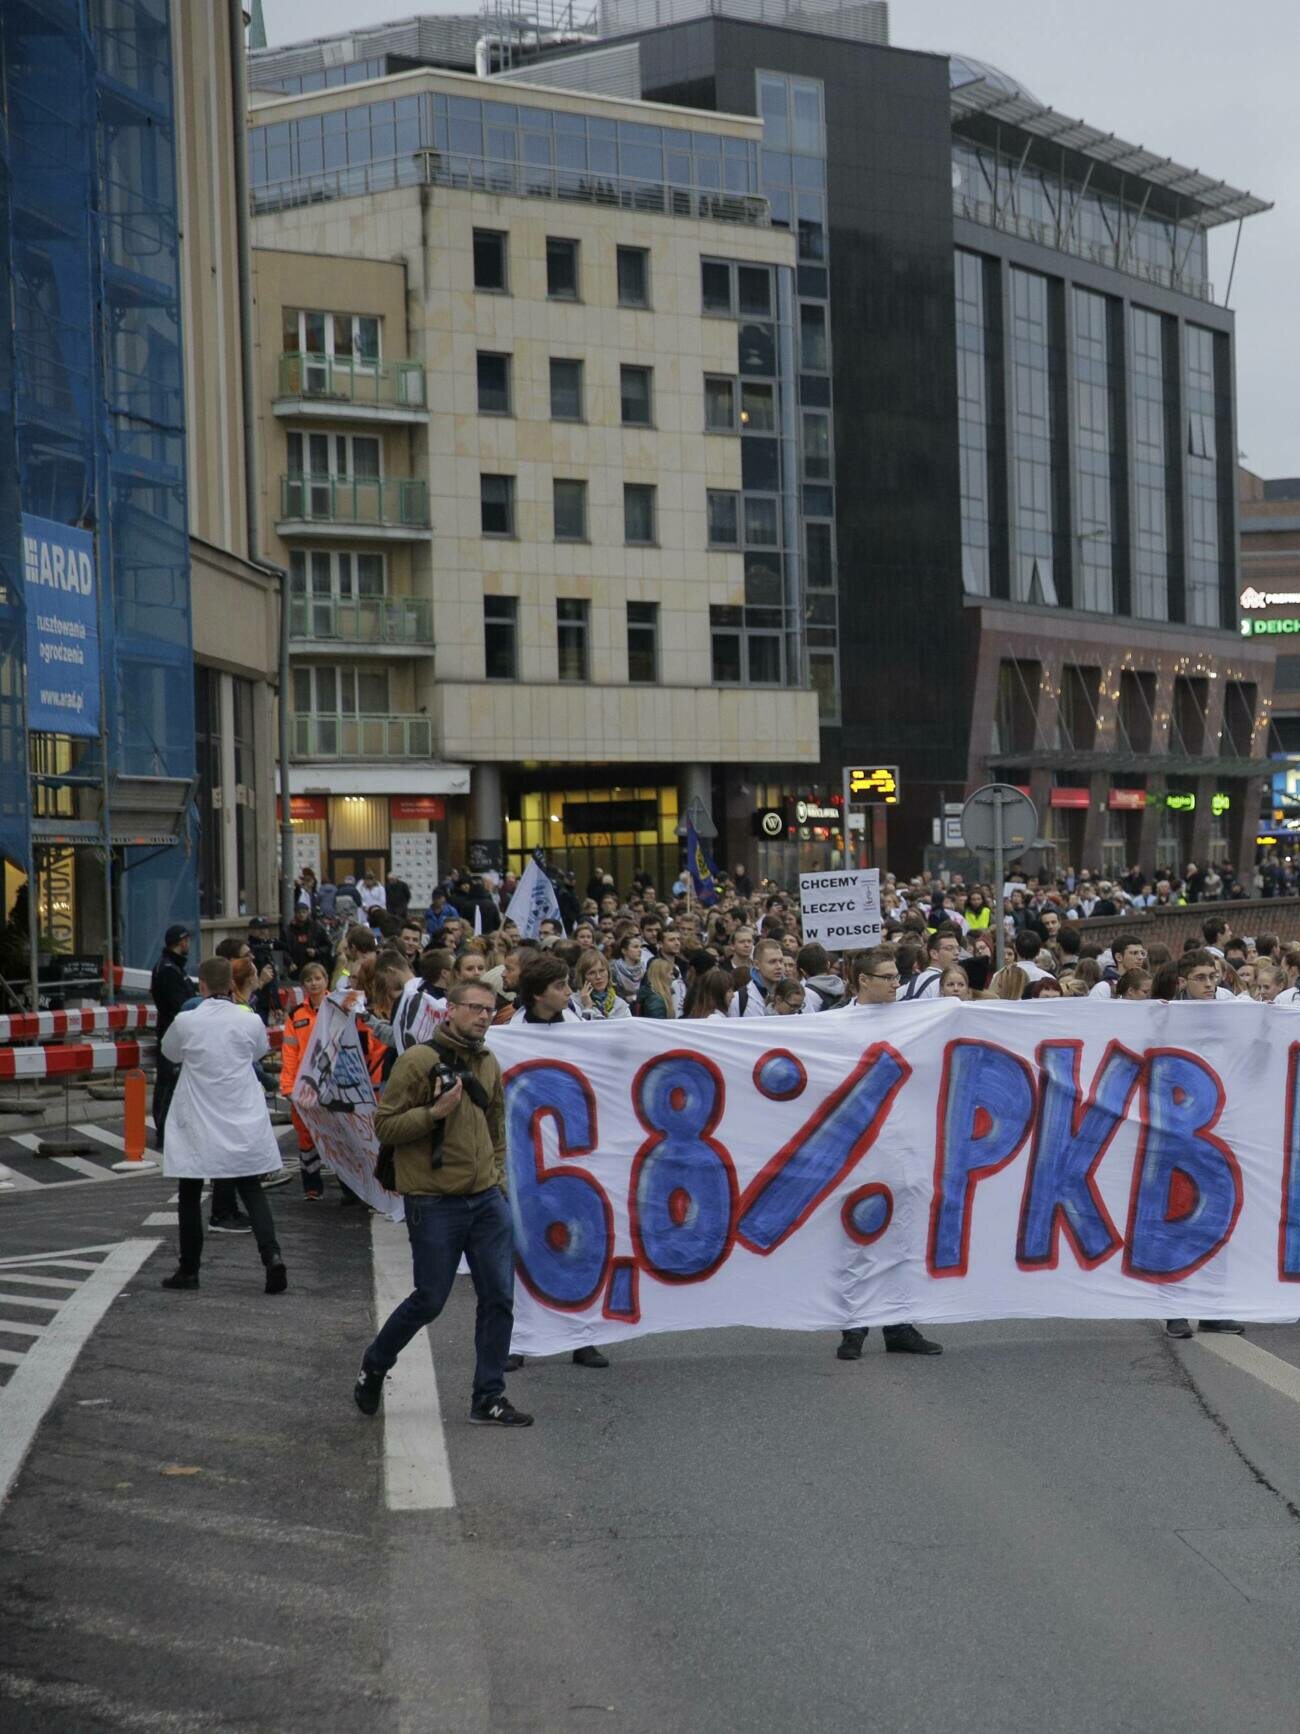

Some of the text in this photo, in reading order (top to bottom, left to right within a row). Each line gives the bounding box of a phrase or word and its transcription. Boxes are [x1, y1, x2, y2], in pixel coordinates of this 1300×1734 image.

[40, 541, 92, 596] ARAD
[37, 614, 86, 640] rusztowania
[39, 640, 85, 665] ogrodzenia
[801, 876, 858, 890] CHCEMY
[802, 899, 856, 914] LECZYĆ
[806, 923, 880, 939] W POLSCE
[501, 1040, 913, 1325] 6,8%
[926, 1038, 1244, 1284] PKB
